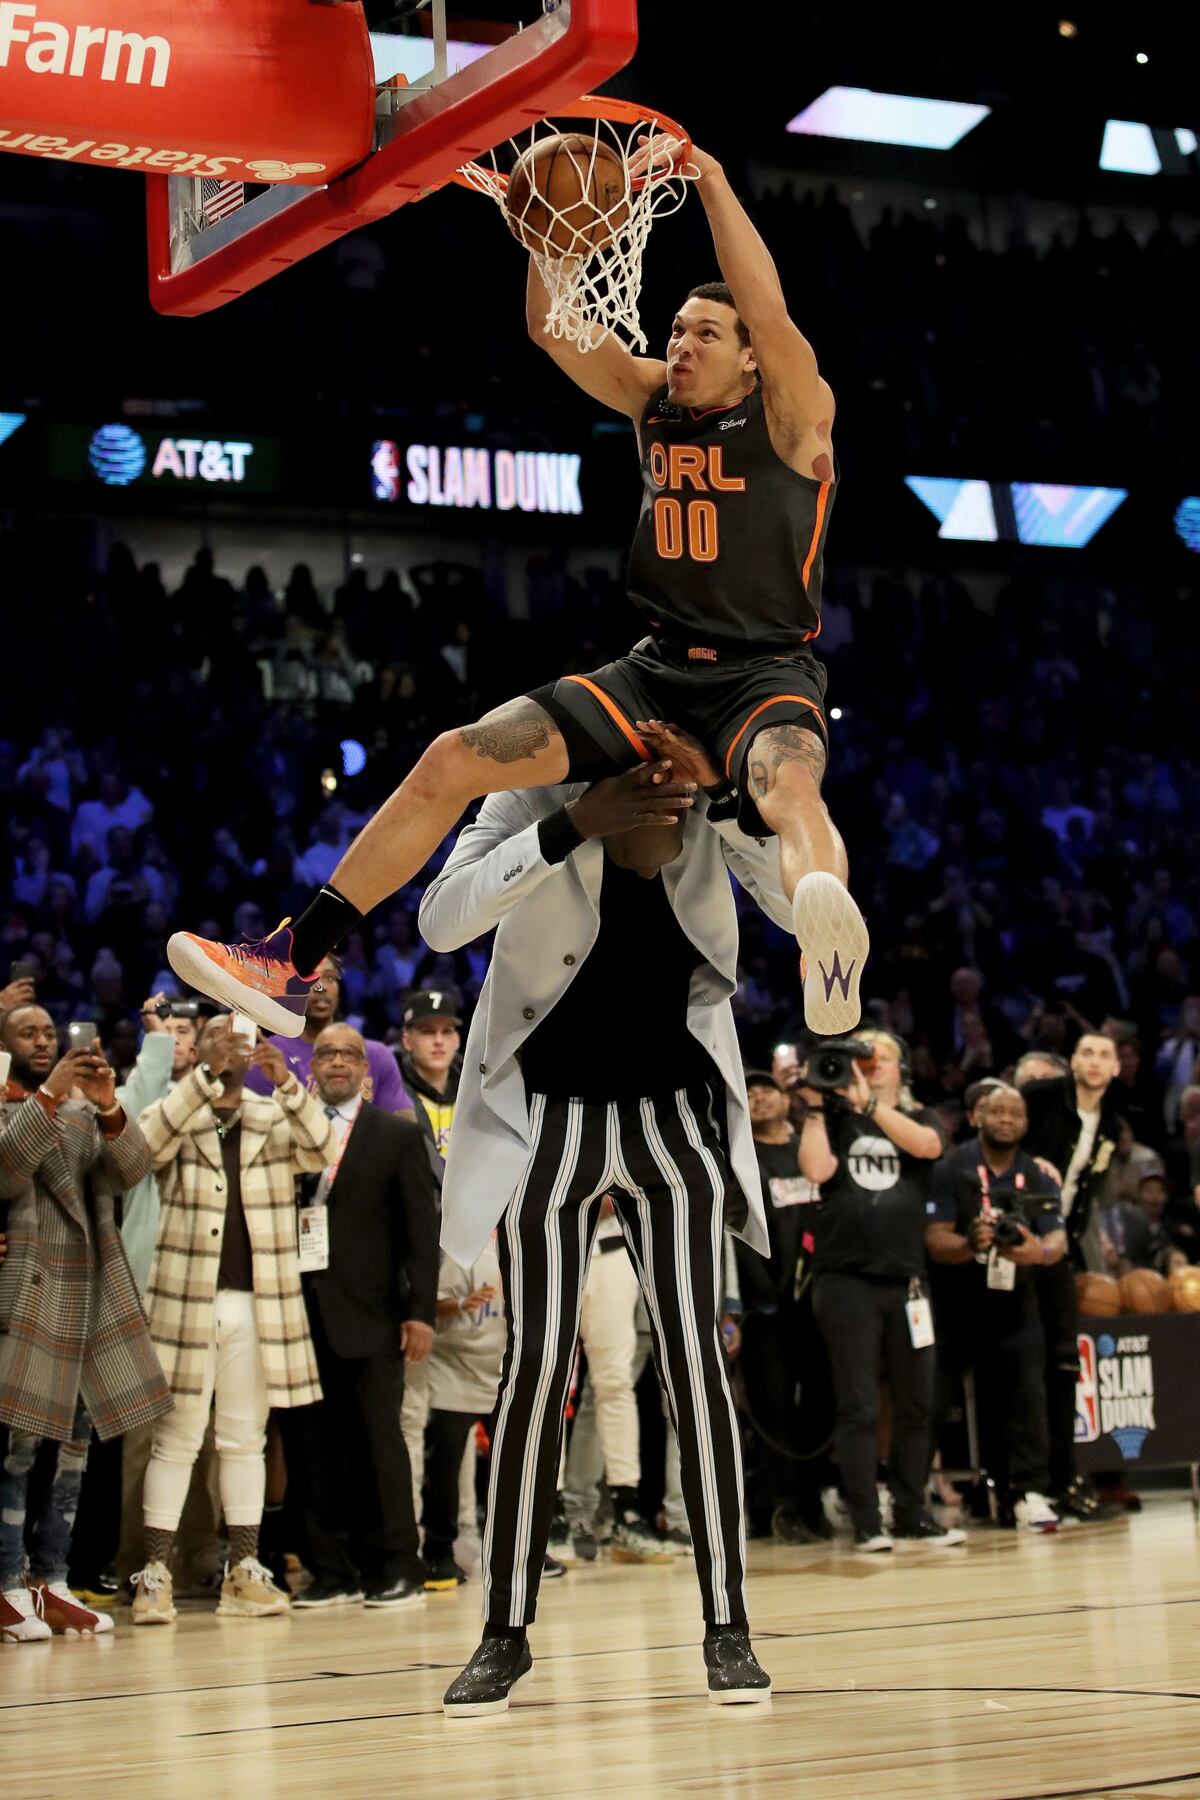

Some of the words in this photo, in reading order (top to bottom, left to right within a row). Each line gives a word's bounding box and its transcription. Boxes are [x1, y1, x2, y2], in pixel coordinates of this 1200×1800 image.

[0, 2, 171, 88] Farm
[718, 417, 747, 431] Disney
[152, 438, 253, 482] AT&T
[406, 444, 491, 509] SLAM
[495, 450, 583, 515] DUNK
[650, 442, 746, 492] ORL
[654, 498, 718, 562] 00
[429, 992, 442, 1010] 7
[849, 1154, 899, 1175] TNT
[1117, 1335, 1149, 1353] AT&T
[1098, 1356, 1154, 1399] SLAM
[1101, 1397, 1156, 1434] DUNK
